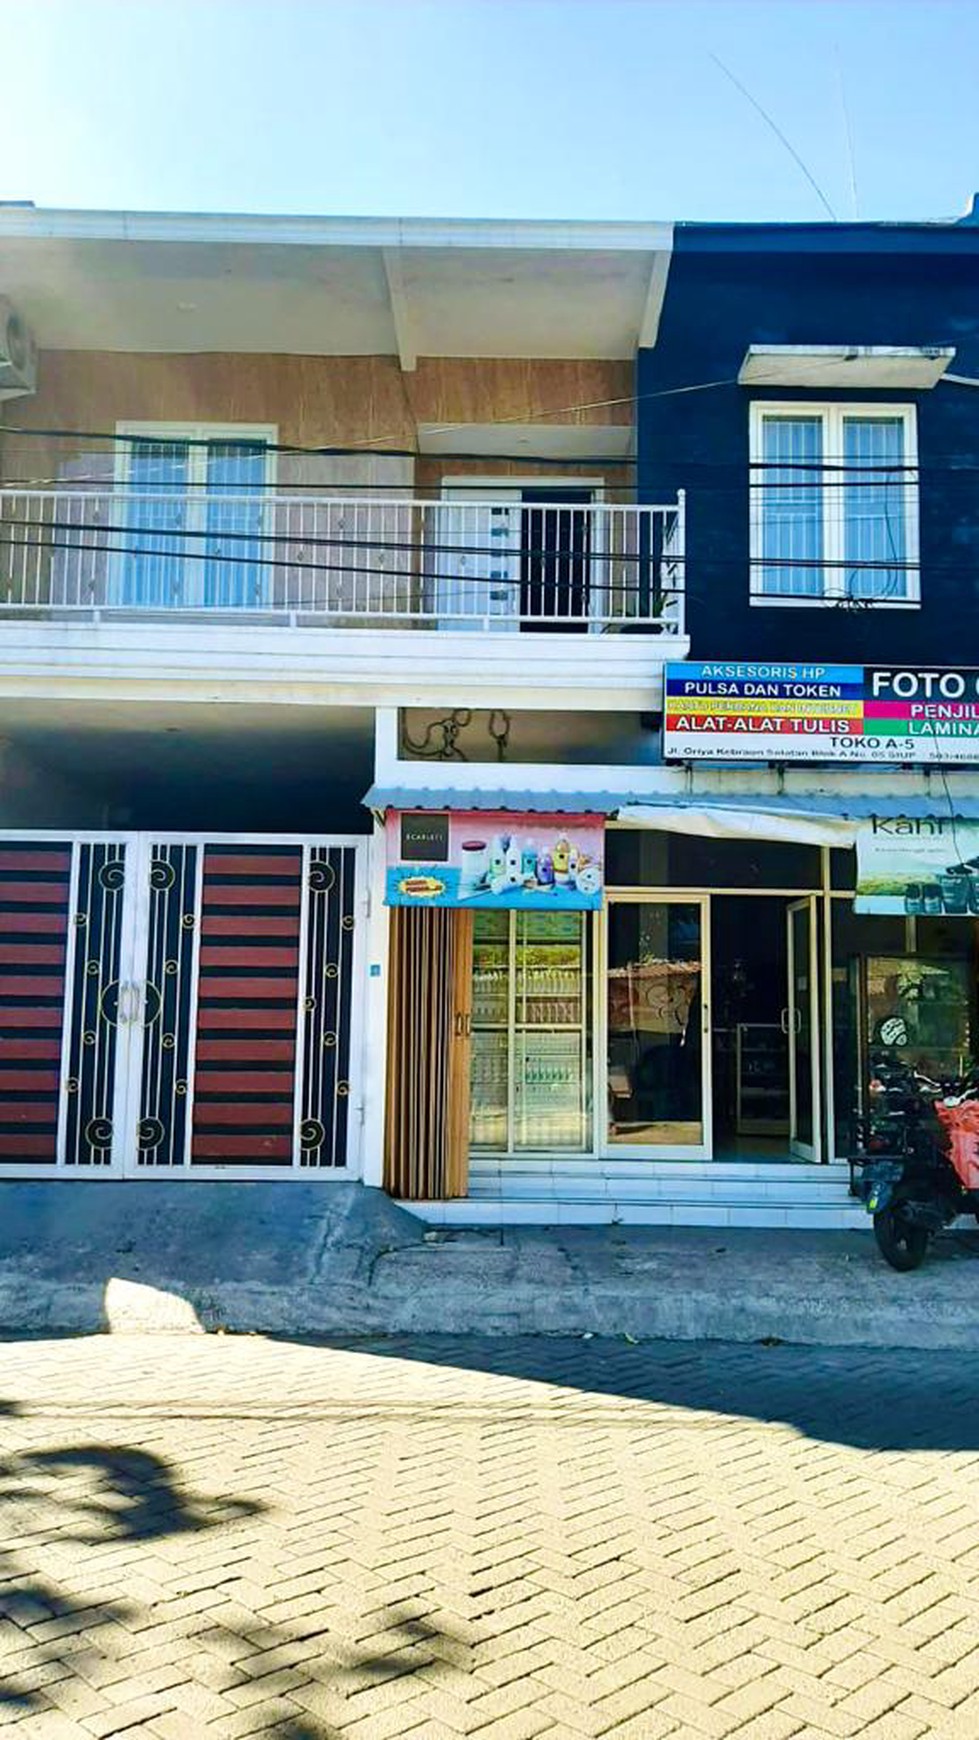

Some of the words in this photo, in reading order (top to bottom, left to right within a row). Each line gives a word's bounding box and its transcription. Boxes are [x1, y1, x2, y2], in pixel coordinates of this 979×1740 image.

[702, 665, 797, 679] AKSESORIS
[802, 667, 825, 679] HP
[684, 681, 740, 695] PULSA
[744, 683, 779, 696] DAN
[783, 683, 841, 697] TOKEN
[872, 671, 965, 698] FOTO
[911, 703, 979, 718] PENJIL
[676, 716, 784, 732] ALAT-ALAT
[789, 718, 850, 733] TULIS
[830, 737, 880, 749] TOKO
[885, 738, 915, 750] A-5
